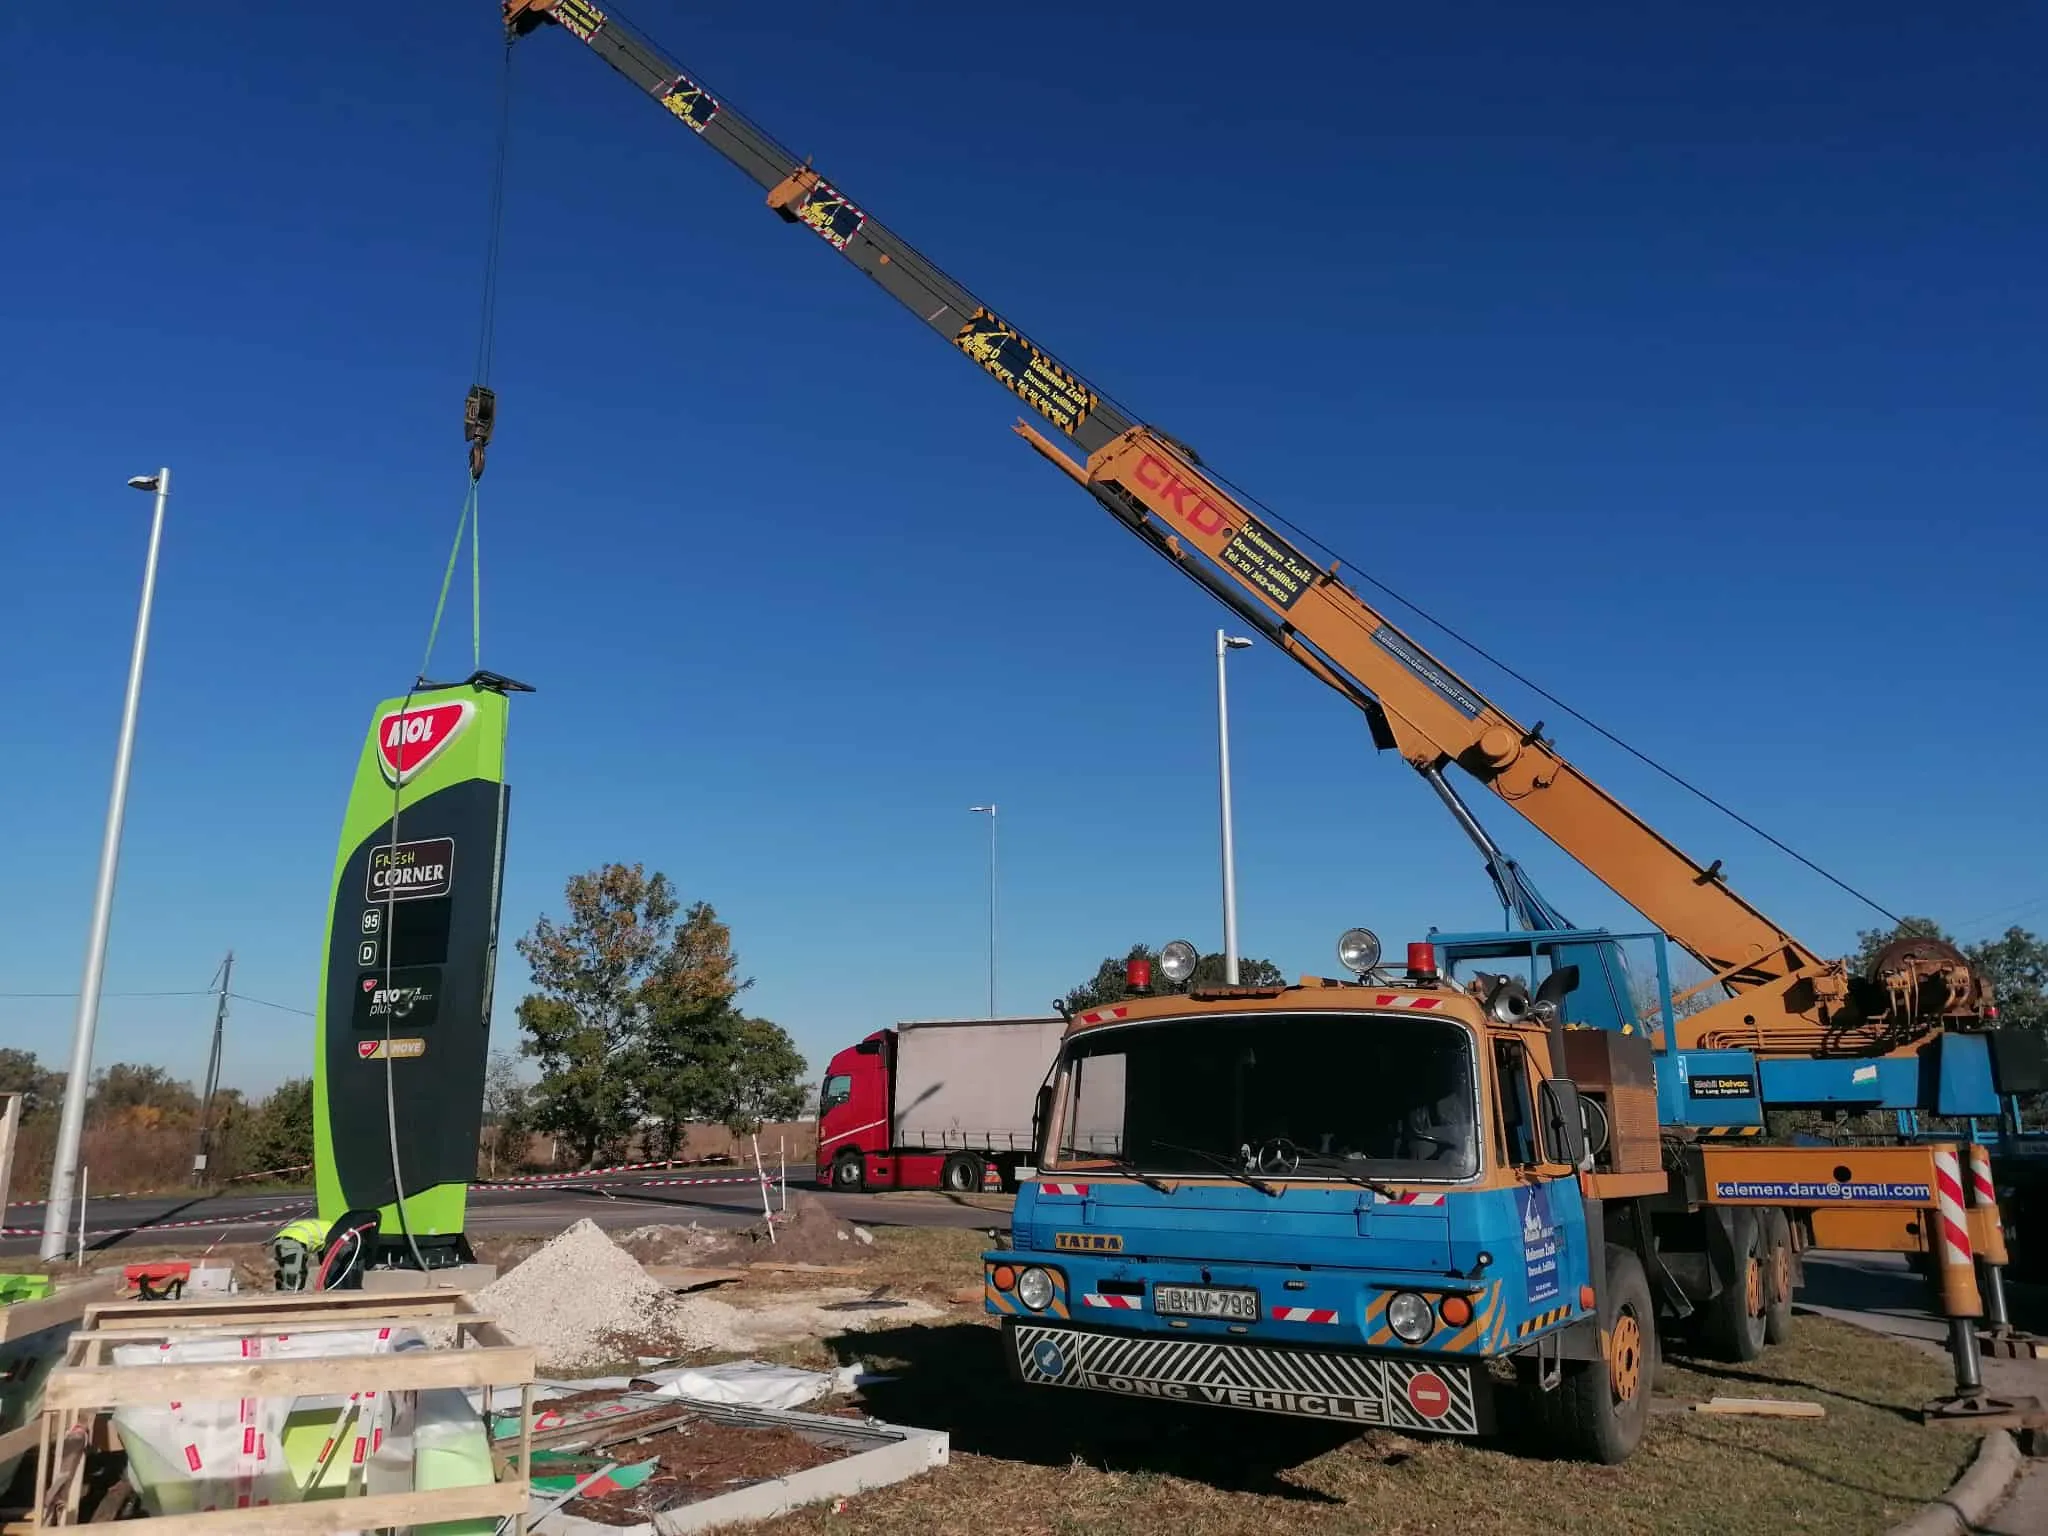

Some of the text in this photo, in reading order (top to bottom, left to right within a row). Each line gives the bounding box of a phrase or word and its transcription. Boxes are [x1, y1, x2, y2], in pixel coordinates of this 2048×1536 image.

[1030, 357, 1088, 407] Kelemen Zsolt
[1133, 454, 1229, 536] CKD
[1241, 523, 1312, 583] Kelemen Zsolt
[386, 715, 434, 747] MOL
[373, 864, 445, 887] CORNER
[364, 914, 379, 929] 95
[362, 946, 373, 960] D
[373, 988, 400, 1004] EVO
[369, 1003, 392, 1017] plus
[1719, 1079, 1749, 1088] Delvac
[1716, 1183, 1930, 1199] kelemen.daru@gmail.com
[1058, 1234, 1120, 1249] TATRA
[1168, 1287, 1256, 1317] BHV-798
[1087, 1374, 1383, 1421] LONG VEHICLE
